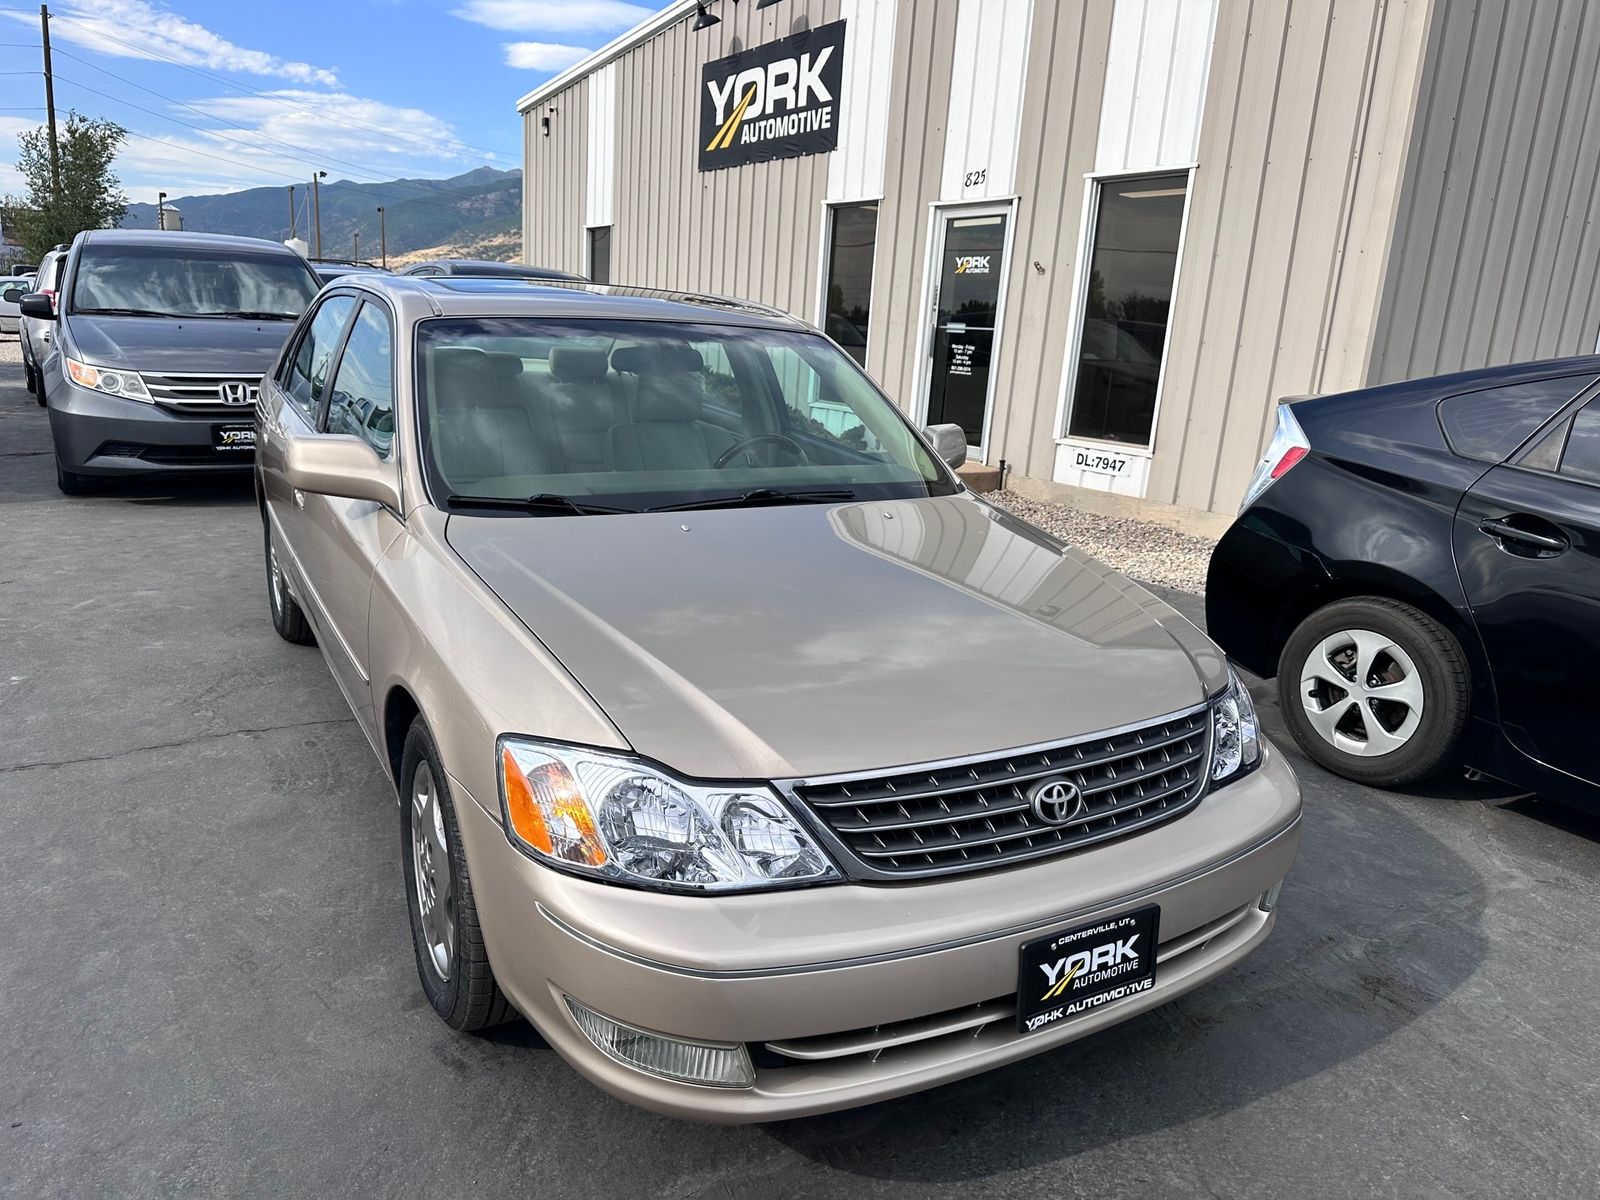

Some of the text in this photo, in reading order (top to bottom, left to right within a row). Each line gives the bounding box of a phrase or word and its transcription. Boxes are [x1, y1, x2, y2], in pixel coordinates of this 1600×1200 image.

[707, 45, 835, 126] YORK
[740, 106, 832, 145] AUTOMOTIVE
[965, 168, 987, 188] 825
[955, 256, 990, 268] YORK
[1076, 453, 1126, 472] DL:7947
[1058, 918, 1130, 945] CENTERVILLE, UT
[1039, 933, 1141, 987] YORK
[1073, 958, 1140, 990] AUTOMOTIVE
[1066, 978, 1153, 1016] AUTOMOTIVE
